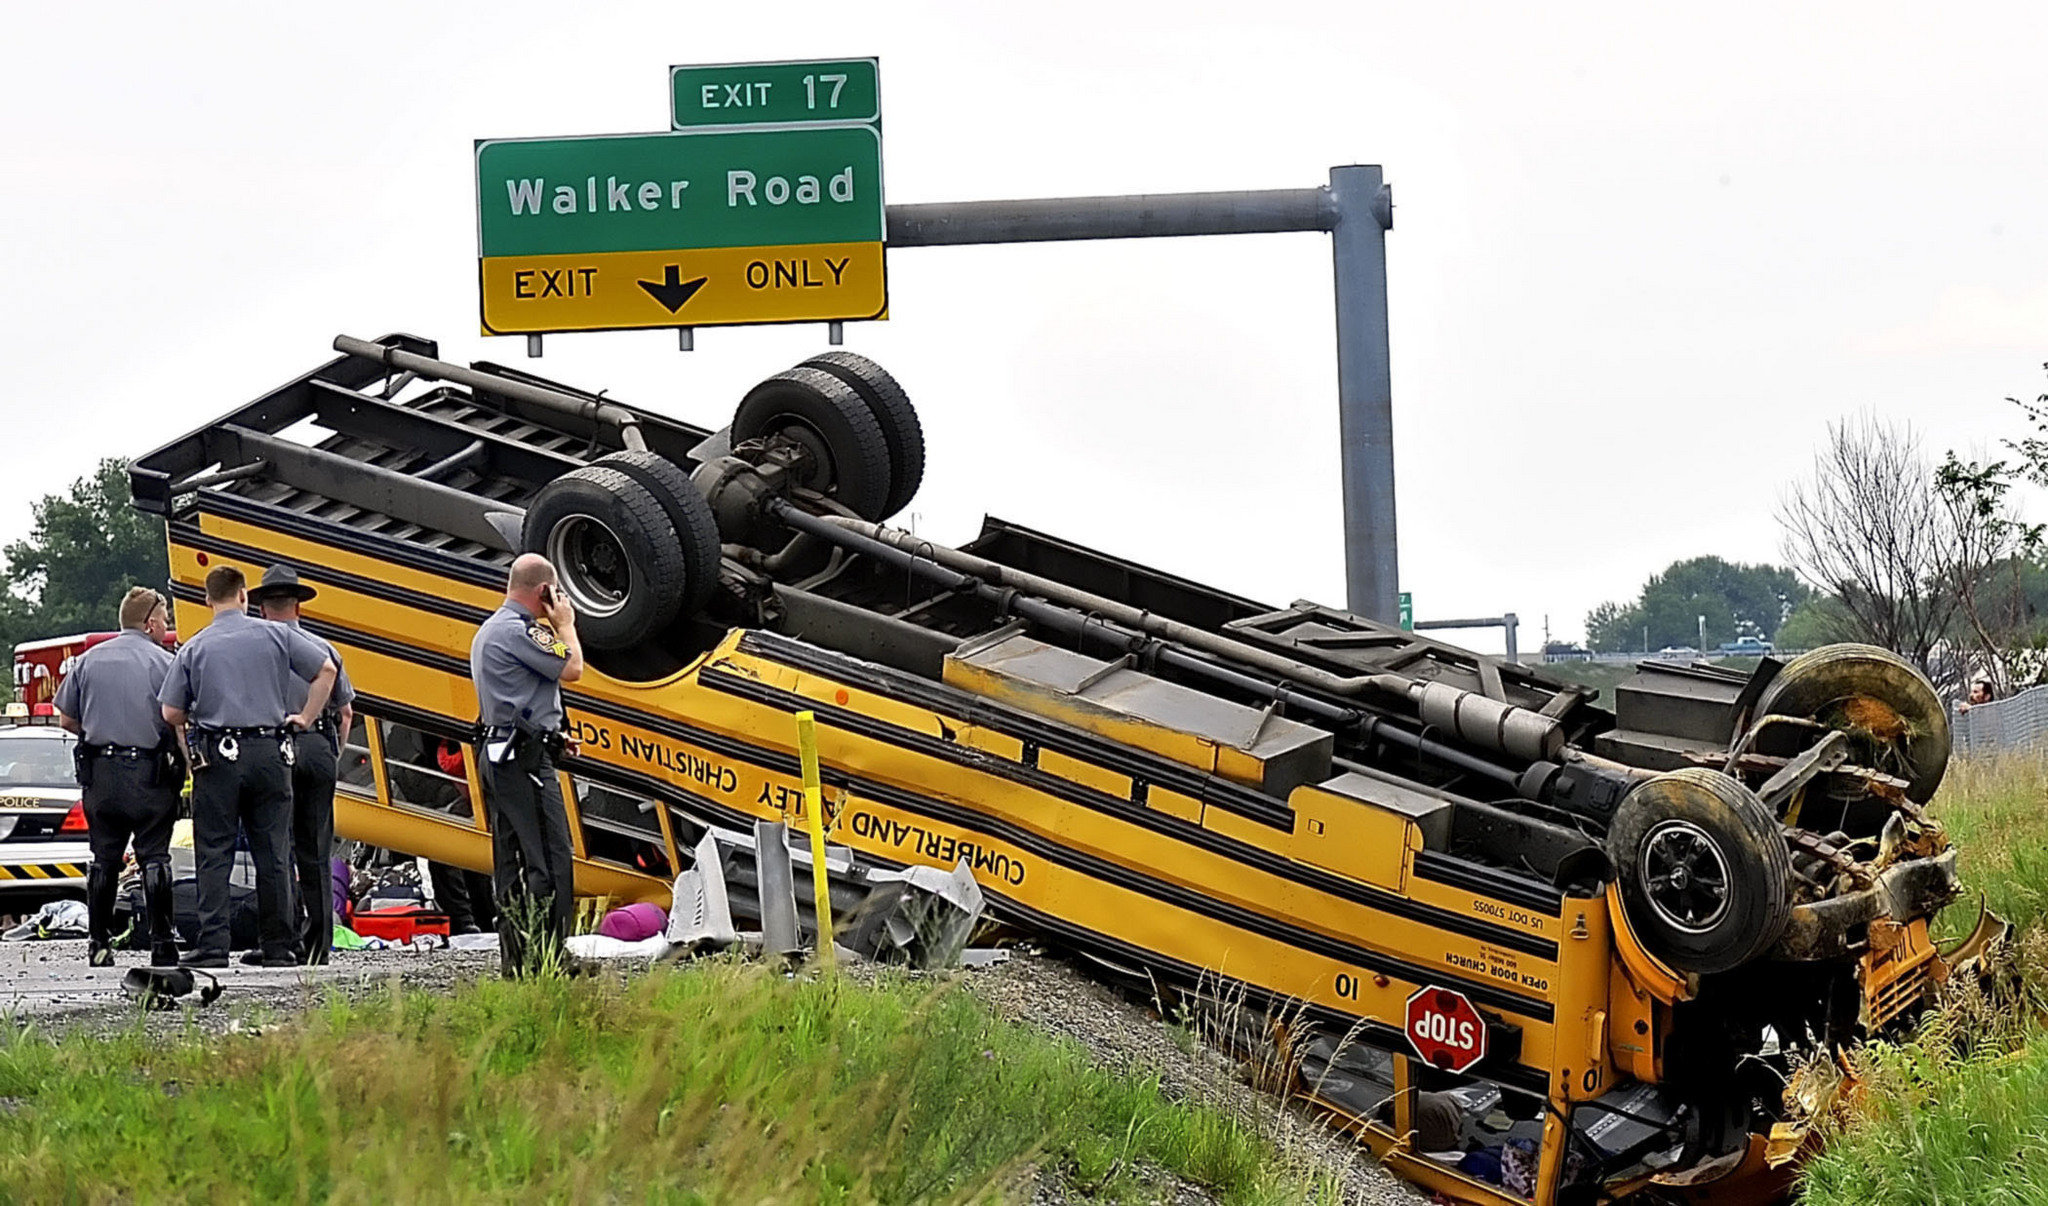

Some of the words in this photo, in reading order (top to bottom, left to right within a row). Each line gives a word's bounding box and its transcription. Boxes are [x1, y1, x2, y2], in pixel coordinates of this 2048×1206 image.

[701, 82, 773, 109] EXIT
[802, 74, 848, 109] 17
[506, 175, 690, 216] Walker
[726, 166, 855, 207] Road
[514, 267, 600, 299] EXIT
[745, 257, 850, 289] ONLY
[620, 734, 738, 793] CHRISTIAN
[757, 780, 843, 831] ALEY
[851, 810, 1027, 886] CUMBERLAND
[1473, 900, 1506, 918] 570055
[1508, 910, 1528, 925] DOT
[1530, 916, 1544, 930] US
[1445, 952, 1487, 973] CHURCH
[1490, 965, 1518, 982] DOOR
[1334, 973, 1359, 1001] 10
[1521, 974, 1548, 991] OPEN
[1414, 1010, 1475, 1051] STOP
[1582, 1066, 1603, 1093] 10
